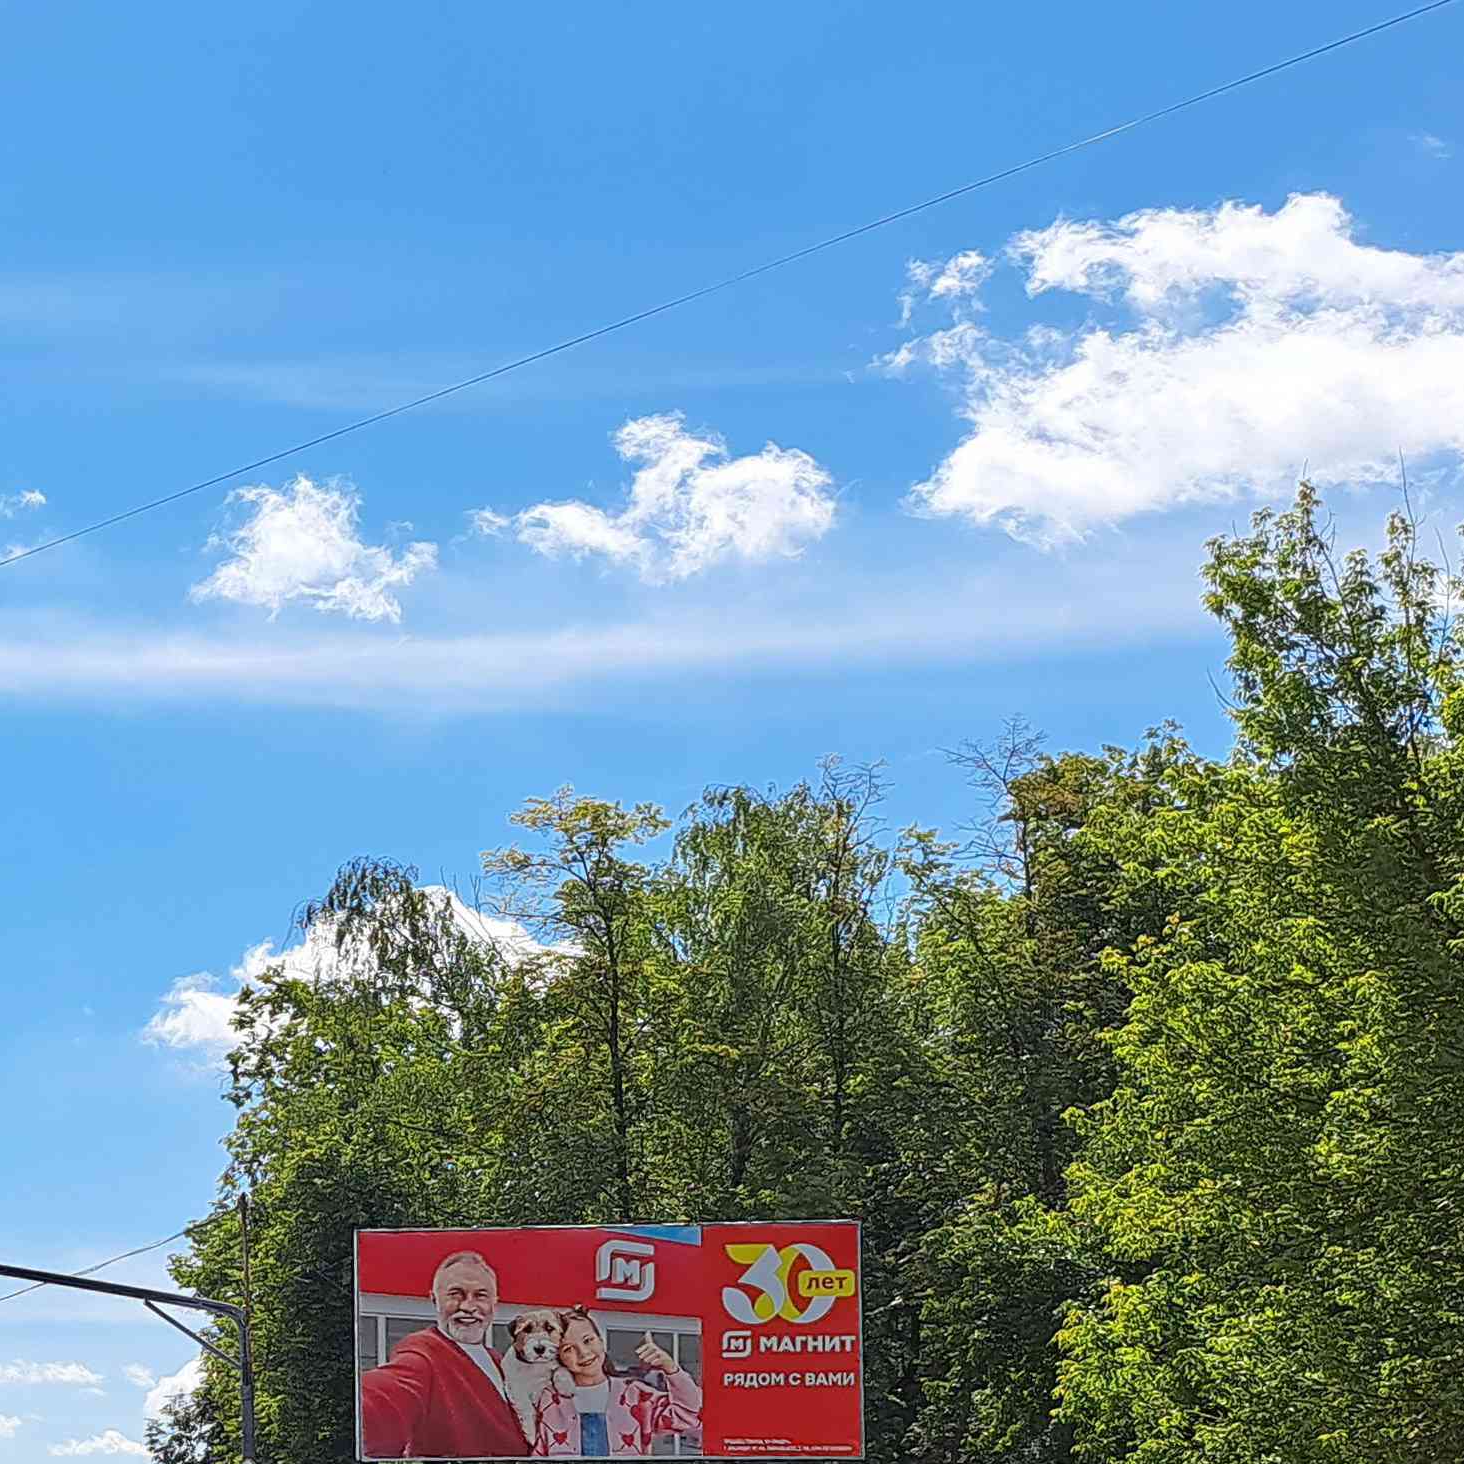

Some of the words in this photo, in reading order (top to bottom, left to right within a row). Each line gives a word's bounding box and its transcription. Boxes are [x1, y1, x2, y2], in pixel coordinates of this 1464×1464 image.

[806, 1274, 848, 1291] лет
[759, 1334, 856, 1354] МАГНИТ
[723, 1372, 783, 1388] РЯДОМ
[789, 1372, 801, 1387] С
[805, 1371, 855, 1387] ВАМИ
